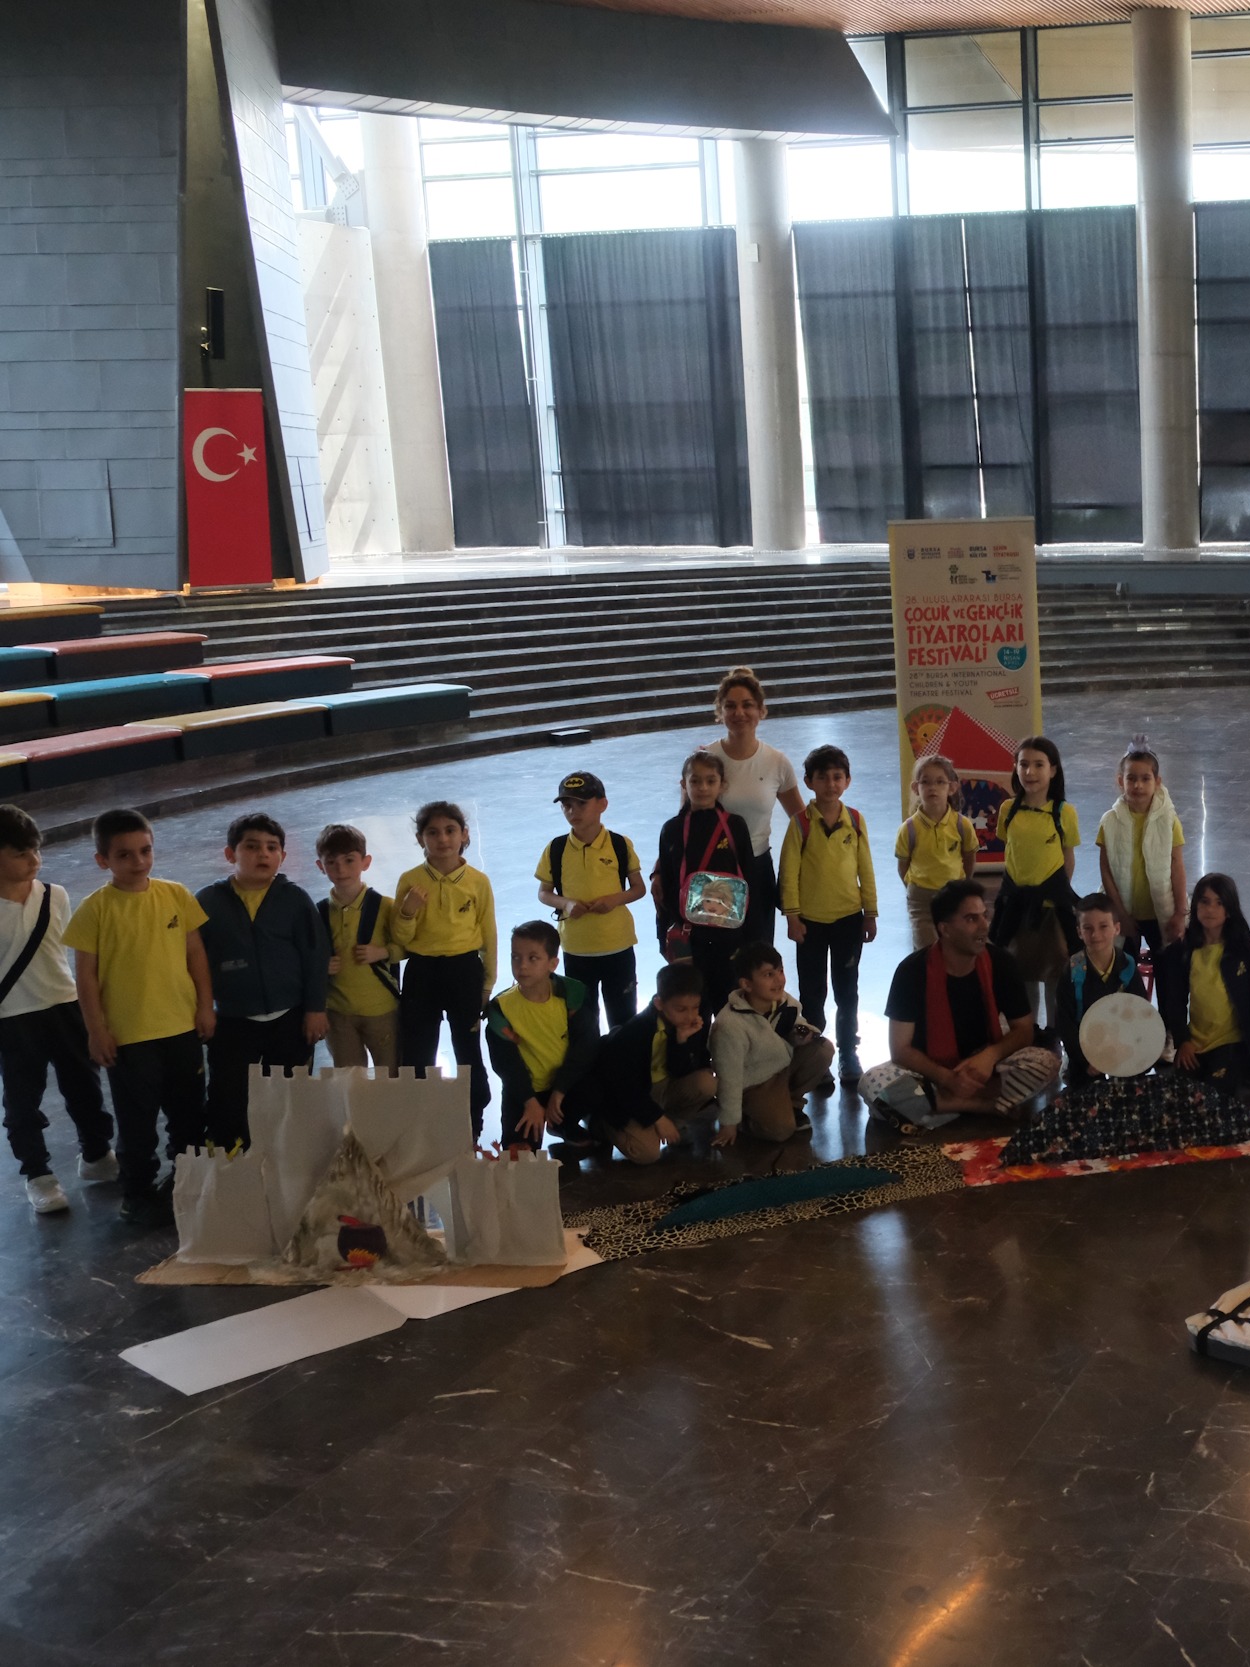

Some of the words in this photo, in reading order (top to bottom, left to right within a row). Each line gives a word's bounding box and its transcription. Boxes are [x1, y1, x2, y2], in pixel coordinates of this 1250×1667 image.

[923, 594, 991, 604] ULUSLARARASI
[994, 593, 1023, 602] BURSA
[904, 605, 950, 624] ÇOCUK
[953, 609, 965, 619] VE
[966, 602, 1024, 622] GENÇLİK
[906, 623, 1025, 645] TİYATROLARI
[908, 641, 988, 666] FESTİVALİ
[951, 670, 1007, 679] INTERNATIONAL
[942, 689, 973, 697] FESTIVAL
